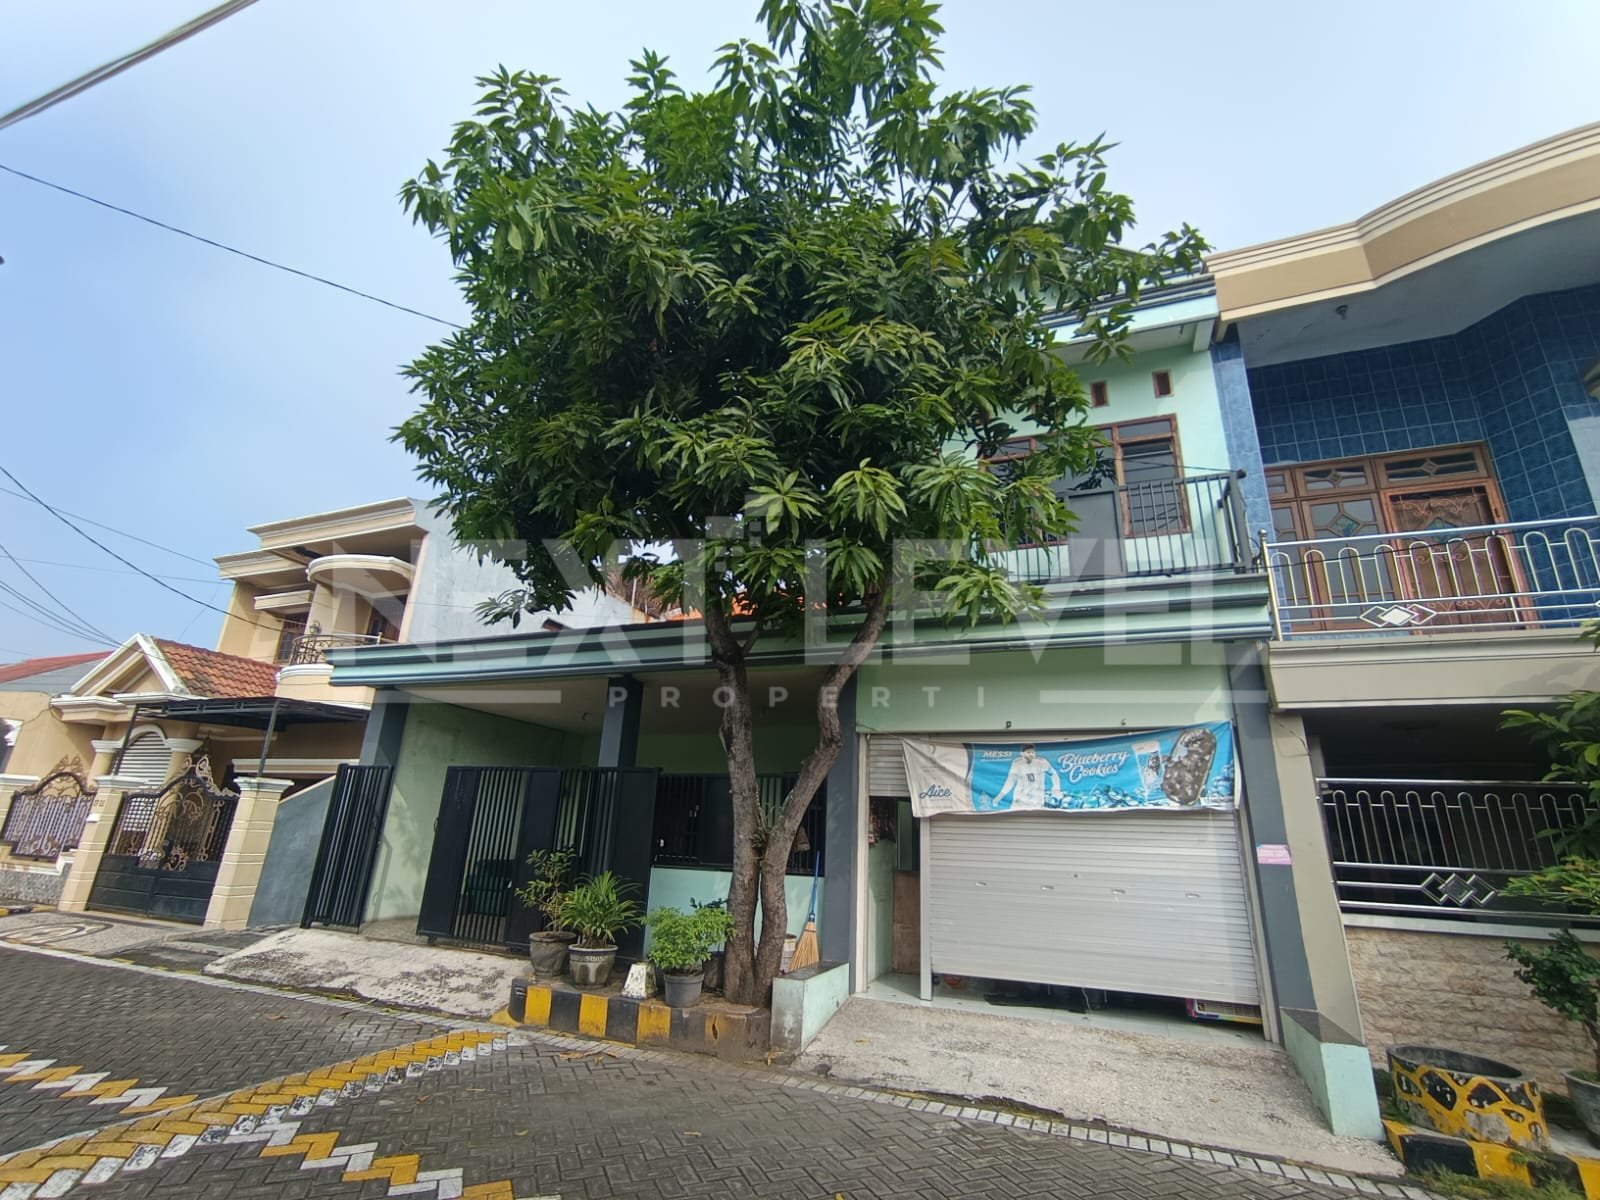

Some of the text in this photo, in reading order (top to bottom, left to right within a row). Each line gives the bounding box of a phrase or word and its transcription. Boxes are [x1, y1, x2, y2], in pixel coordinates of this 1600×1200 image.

[982, 750, 1013, 759] MESSI
[1058, 750, 1130, 773] Blueberry
[1025, 773, 1036, 783] 10
[1069, 763, 1120, 784] Cookies
[918, 784, 953, 799] Aice
